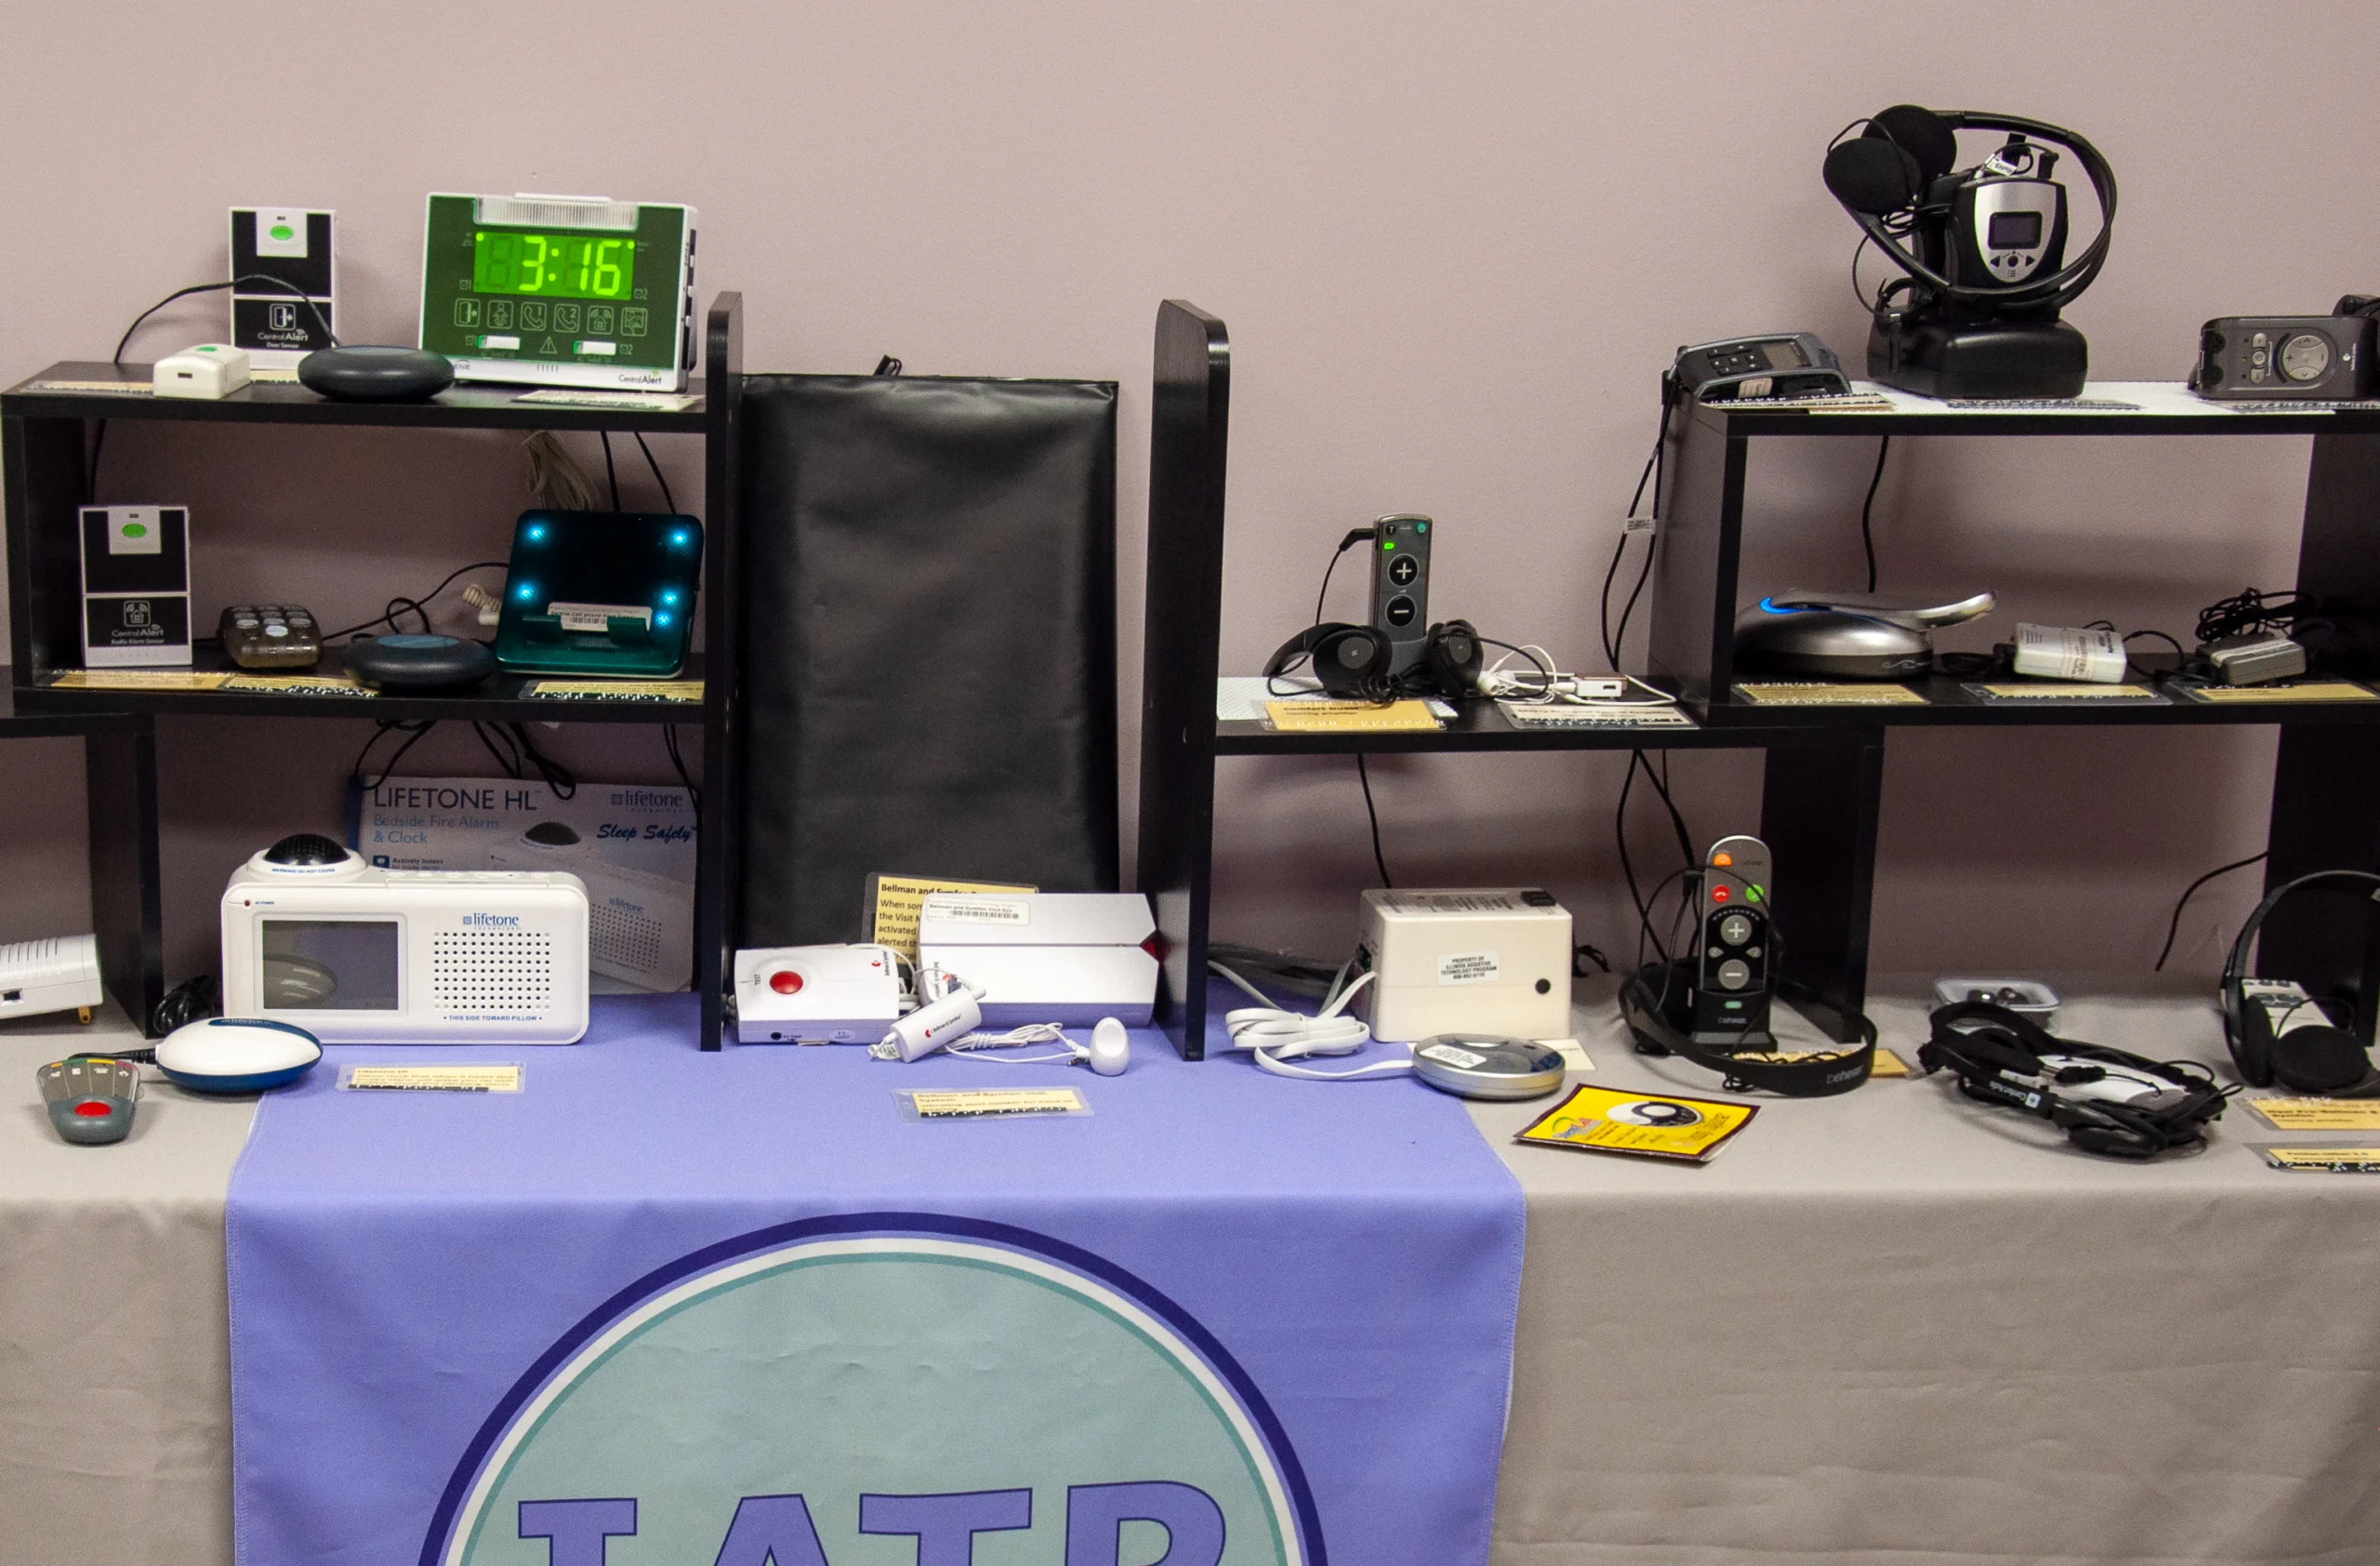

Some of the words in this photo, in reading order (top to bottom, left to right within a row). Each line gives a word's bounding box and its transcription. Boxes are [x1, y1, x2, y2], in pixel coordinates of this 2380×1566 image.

[518, 235, 626, 297] 3:16
[257, 331, 308, 341] CentralAlert
[618, 374, 662, 384] CentralAlert
[374, 788, 495, 810] LIFETONE
[625, 790, 683, 807] lifetone
[373, 814, 425, 827] Bedside
[430, 815, 455, 828] Fire
[459, 816, 500, 829] Alarm
[373, 831, 383, 843] &
[388, 830, 428, 843] Clock
[596, 823, 637, 842] Sleep
[881, 884, 916, 893] Bellman
[880, 899, 905, 909] When
[474, 912, 519, 926] lifetone
[879, 912, 895, 921] the
[895, 913, 913, 922] Visit
[878, 925, 917, 935] activated
[877, 937, 907, 947] alerted
